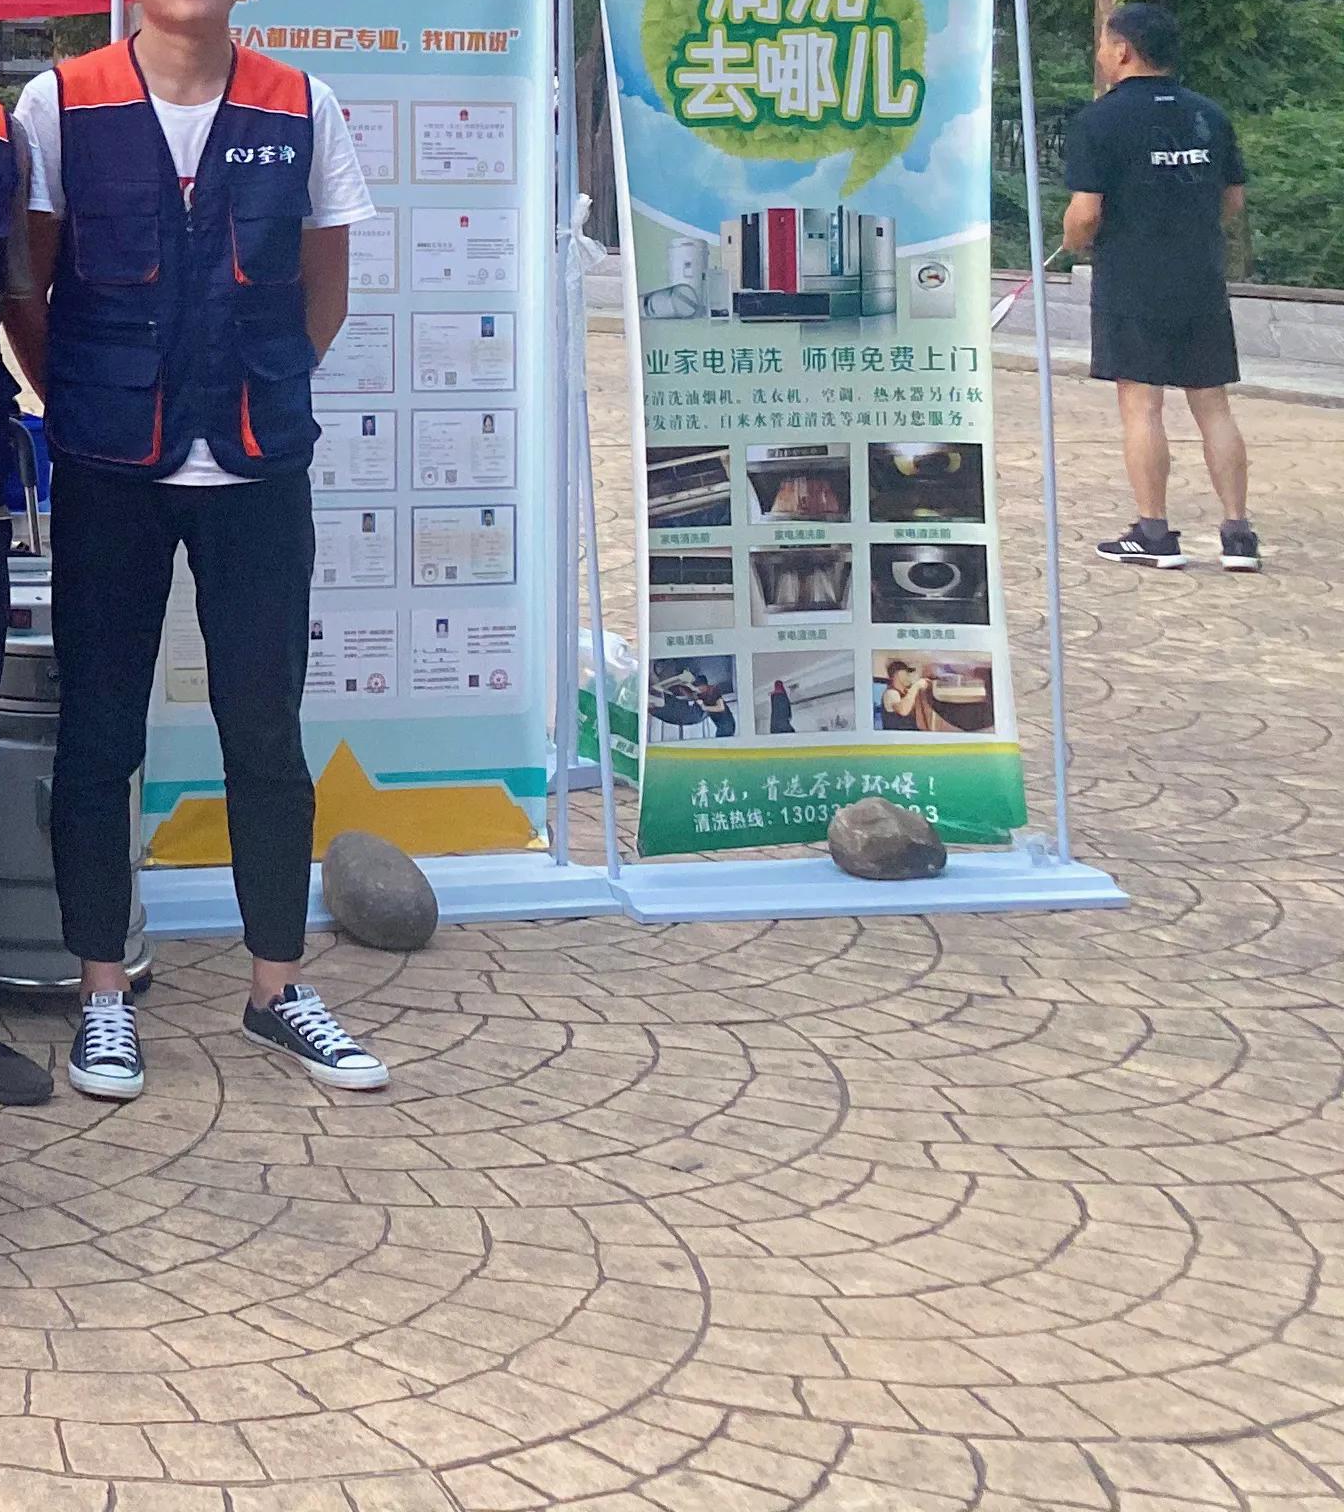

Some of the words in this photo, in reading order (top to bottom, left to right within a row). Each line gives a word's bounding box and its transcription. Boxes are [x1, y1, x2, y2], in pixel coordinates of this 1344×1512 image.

[678, 26, 919, 121] 去哪儿
[256, 145, 296, 165] 荃净
[645, 347, 784, 376] 业家电清洗
[801, 345, 979, 375] 师傅免费上门
